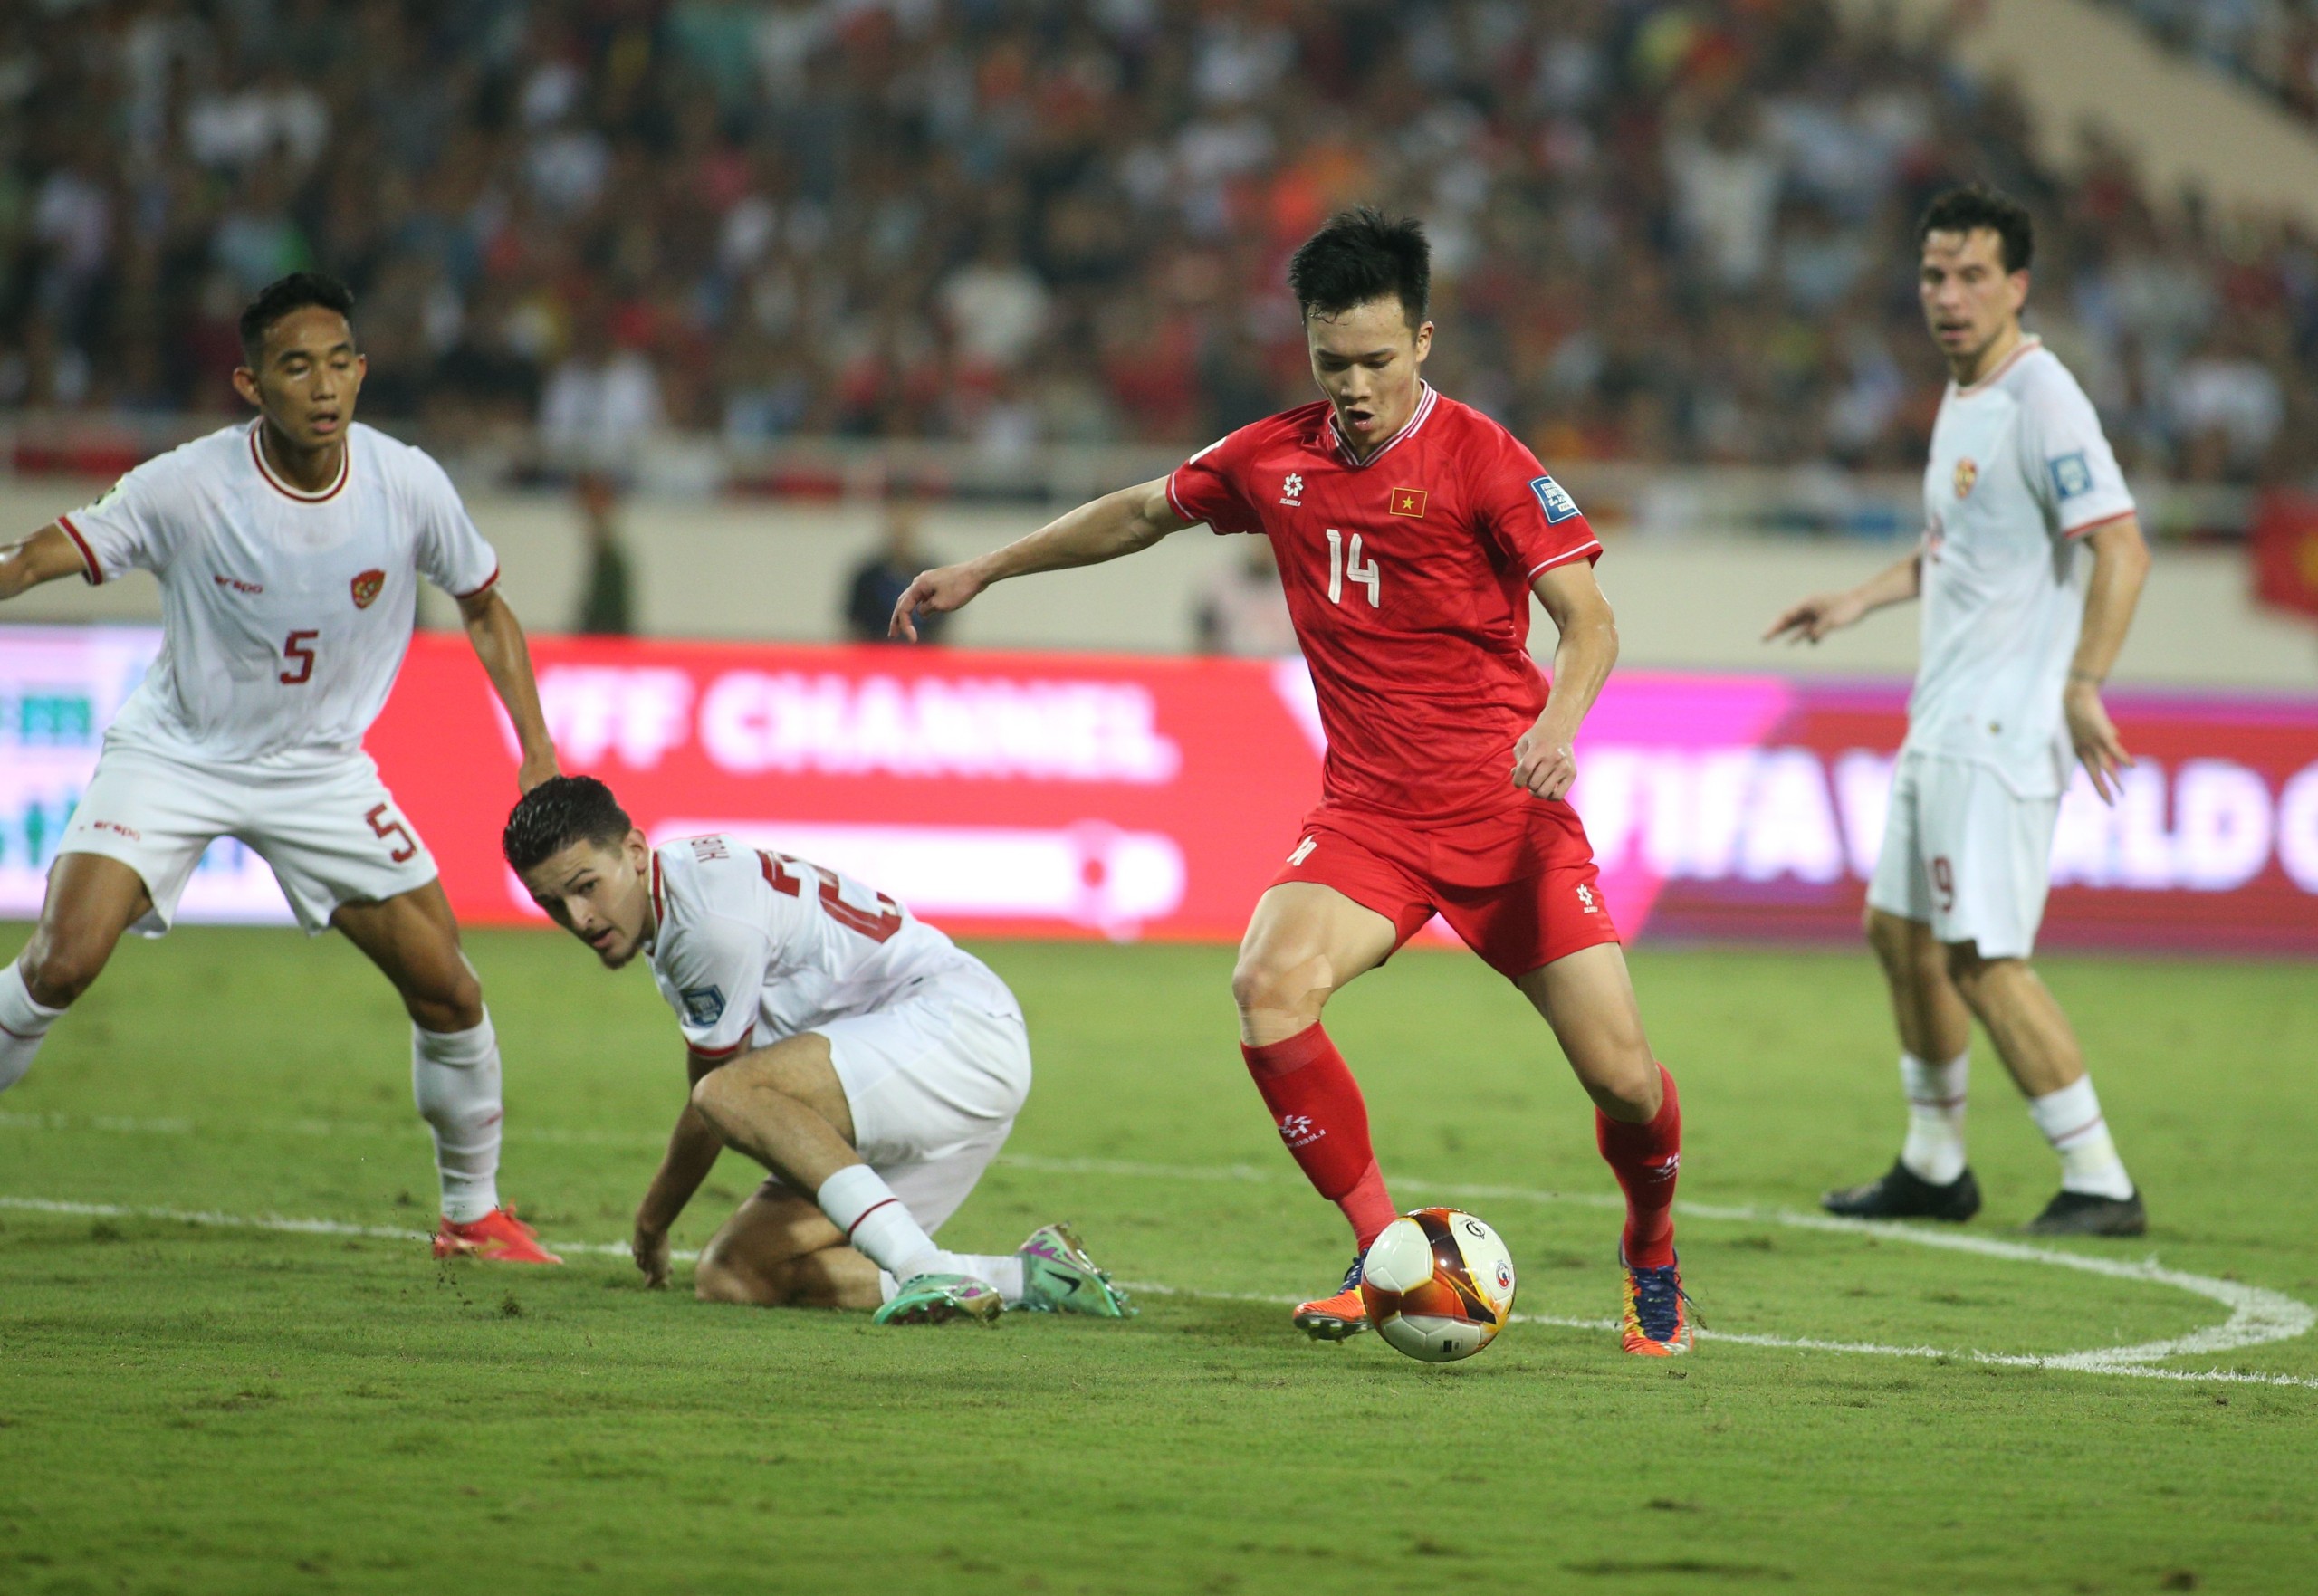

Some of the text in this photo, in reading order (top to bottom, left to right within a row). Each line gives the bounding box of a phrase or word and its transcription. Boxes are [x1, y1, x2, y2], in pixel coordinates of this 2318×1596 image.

[1326, 530, 1380, 608] 14
[280, 630, 318, 683] 5
[699, 669, 1180, 785] CHANNEL
[365, 802, 417, 863] 5
[1931, 855, 1954, 913] 9
